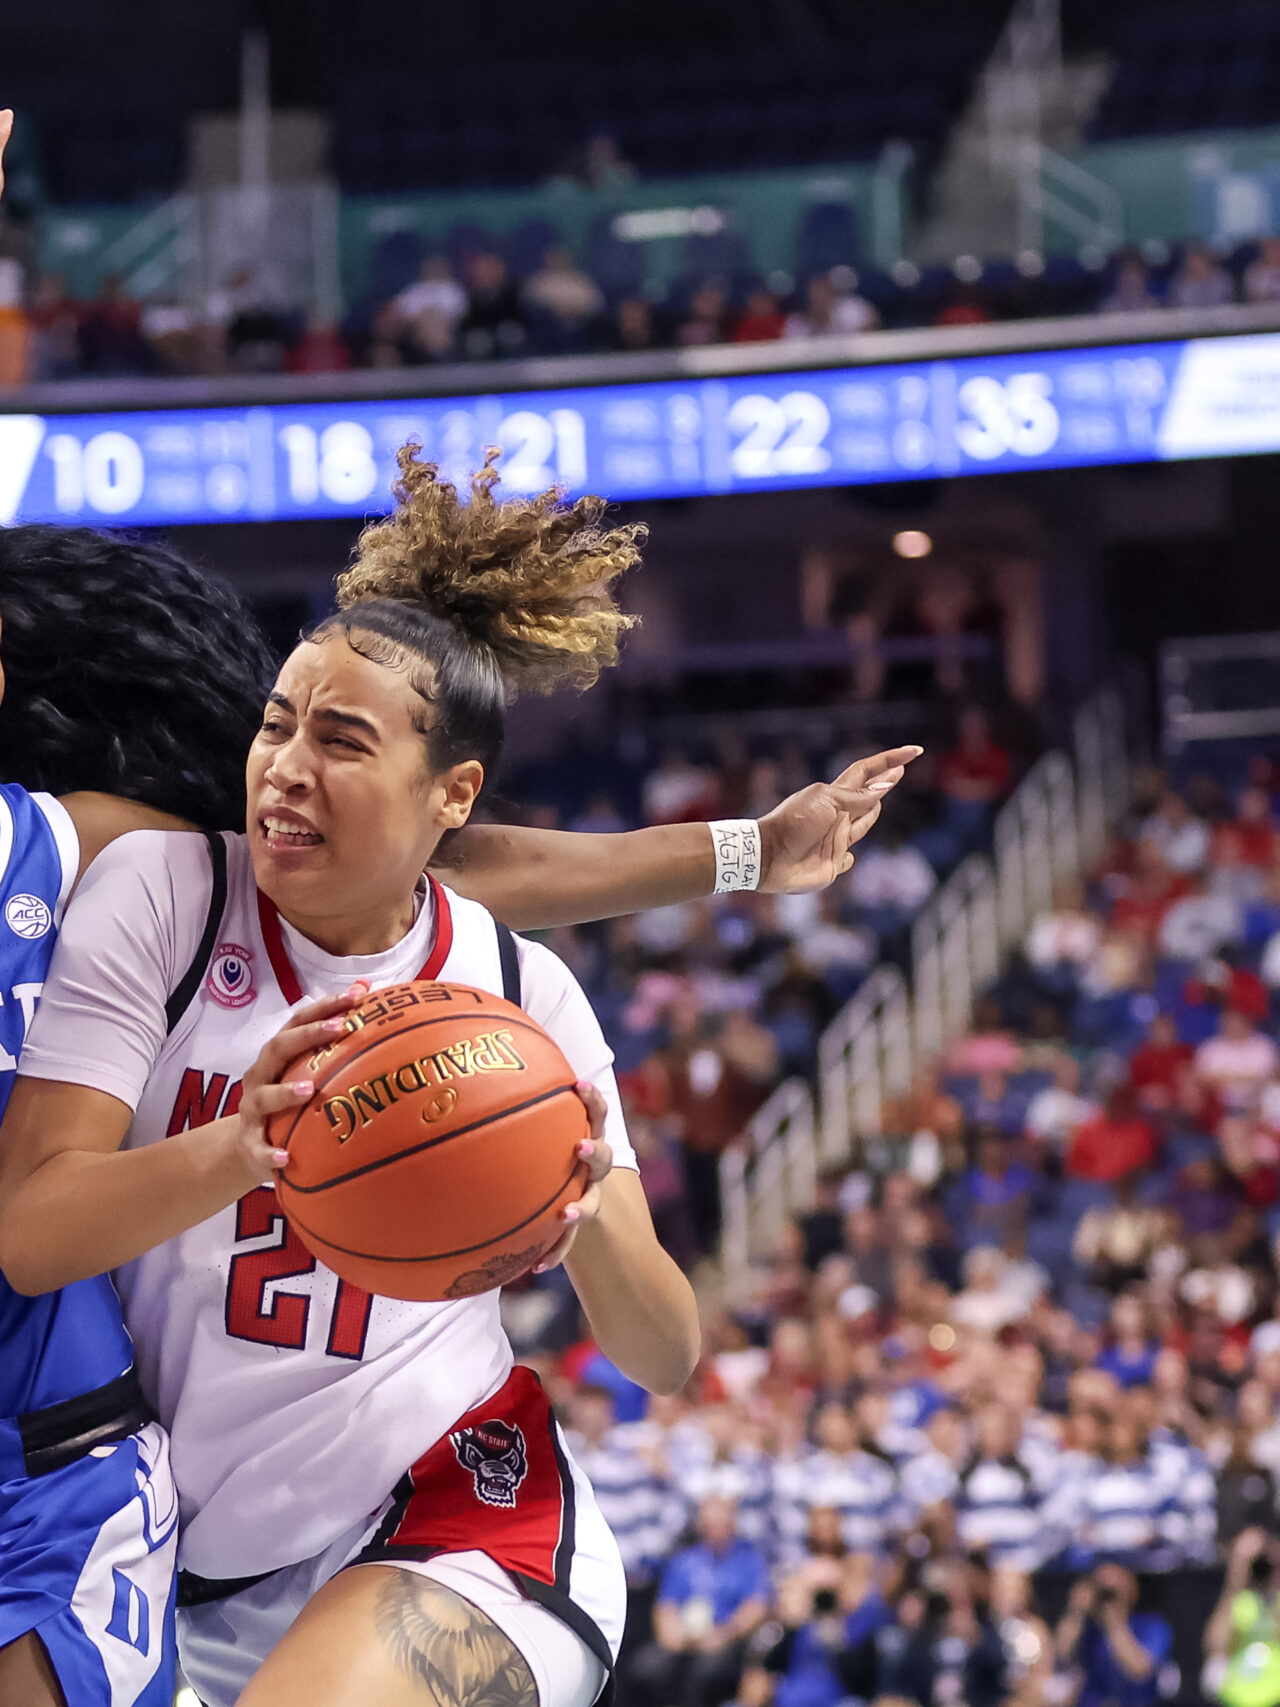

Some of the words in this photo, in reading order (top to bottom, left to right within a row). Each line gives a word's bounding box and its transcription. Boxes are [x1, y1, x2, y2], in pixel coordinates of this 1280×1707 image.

[496, 409, 588, 490] 21
[727, 391, 832, 478] 22
[956, 372, 1060, 460] 35
[44, 431, 144, 514] 10
[279, 420, 378, 506] 18
[716, 830, 739, 883] AGTG
[741, 827, 755, 856] JUST
[741, 863, 756, 887] PLAY
[12, 907, 45, 920] ACC
[323, 1028, 528, 1144] SPALDING
